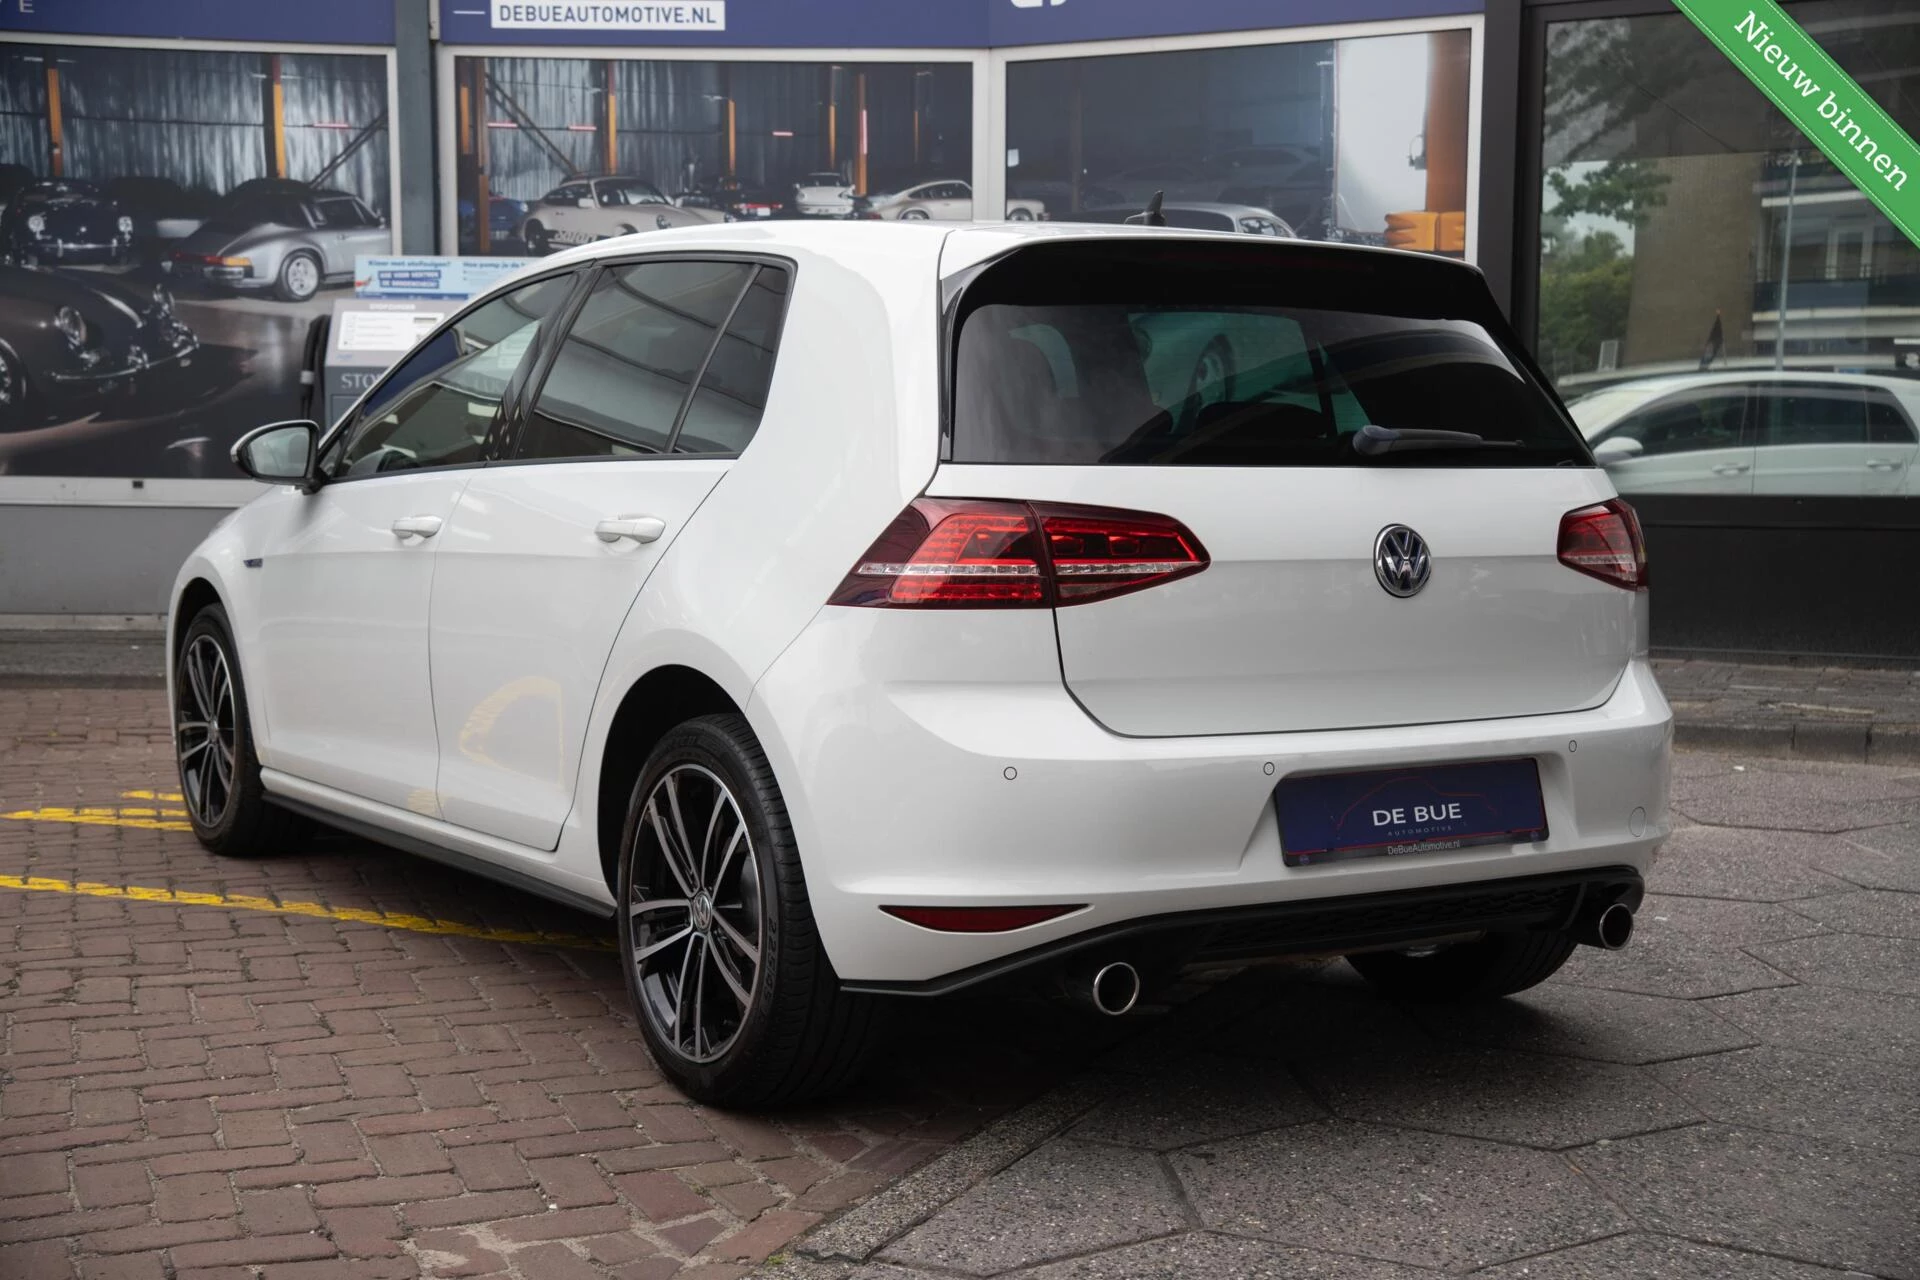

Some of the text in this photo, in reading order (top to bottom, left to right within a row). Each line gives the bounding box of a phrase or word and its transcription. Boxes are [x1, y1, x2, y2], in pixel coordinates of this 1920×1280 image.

[499, 5, 717, 23] DEBUEAUTOMOTIVE.NL
[1372, 802, 1462, 827] DE BUE
[1387, 825, 1452, 837] AUTOMOTIVE
[1387, 840, 1460, 855] DeBueAutomotive.nl
